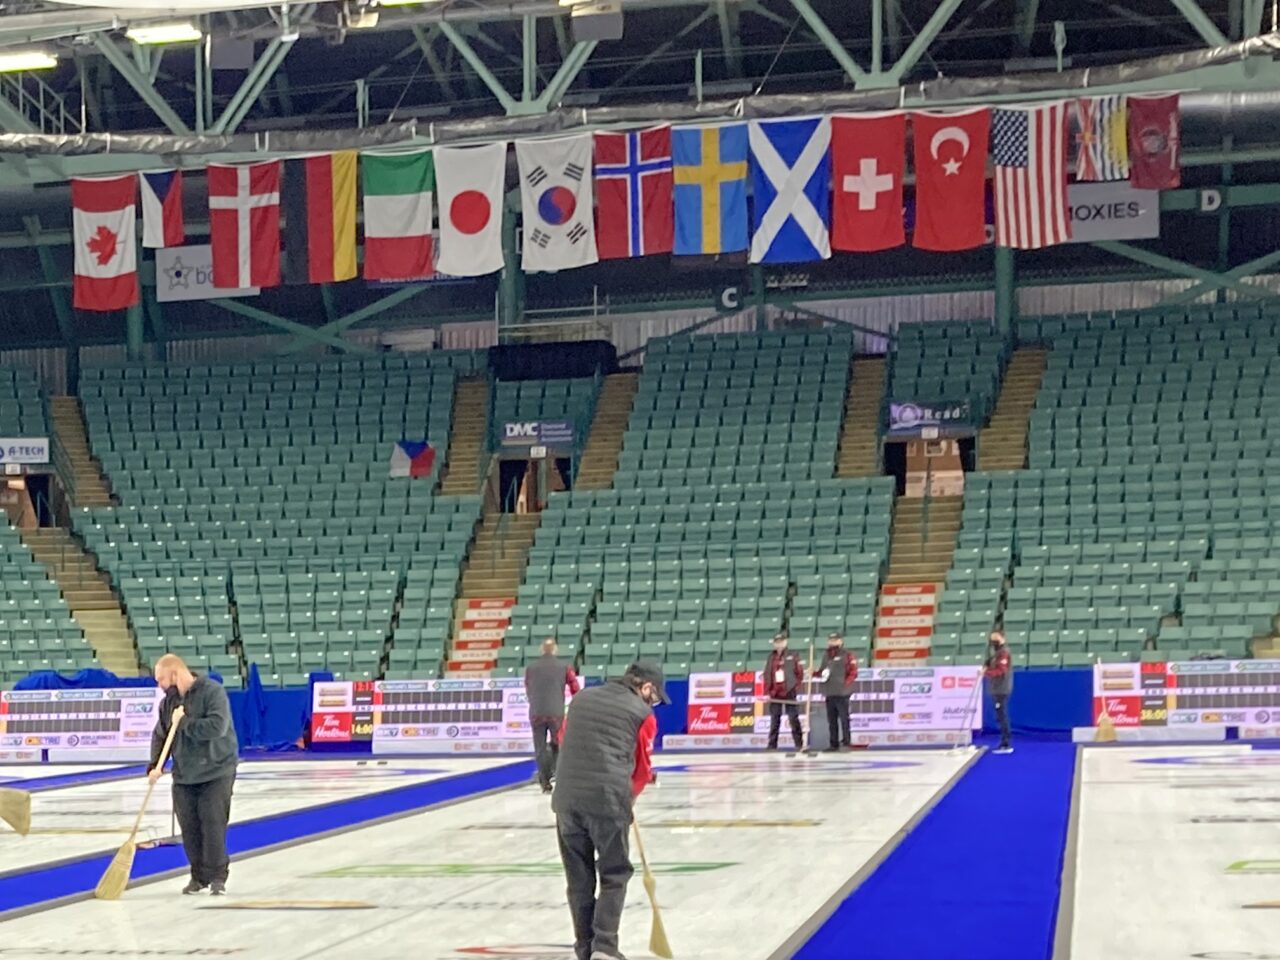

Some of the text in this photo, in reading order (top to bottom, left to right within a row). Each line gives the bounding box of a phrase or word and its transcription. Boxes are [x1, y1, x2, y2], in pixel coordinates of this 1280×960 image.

[1201, 189, 1222, 211] D
[1068, 201, 1140, 222] OXIES
[721, 287, 738, 308] C
[505, 422, 539, 436] DMC
[323, 714, 340, 726] Tim
[699, 706, 719, 719] Tim
